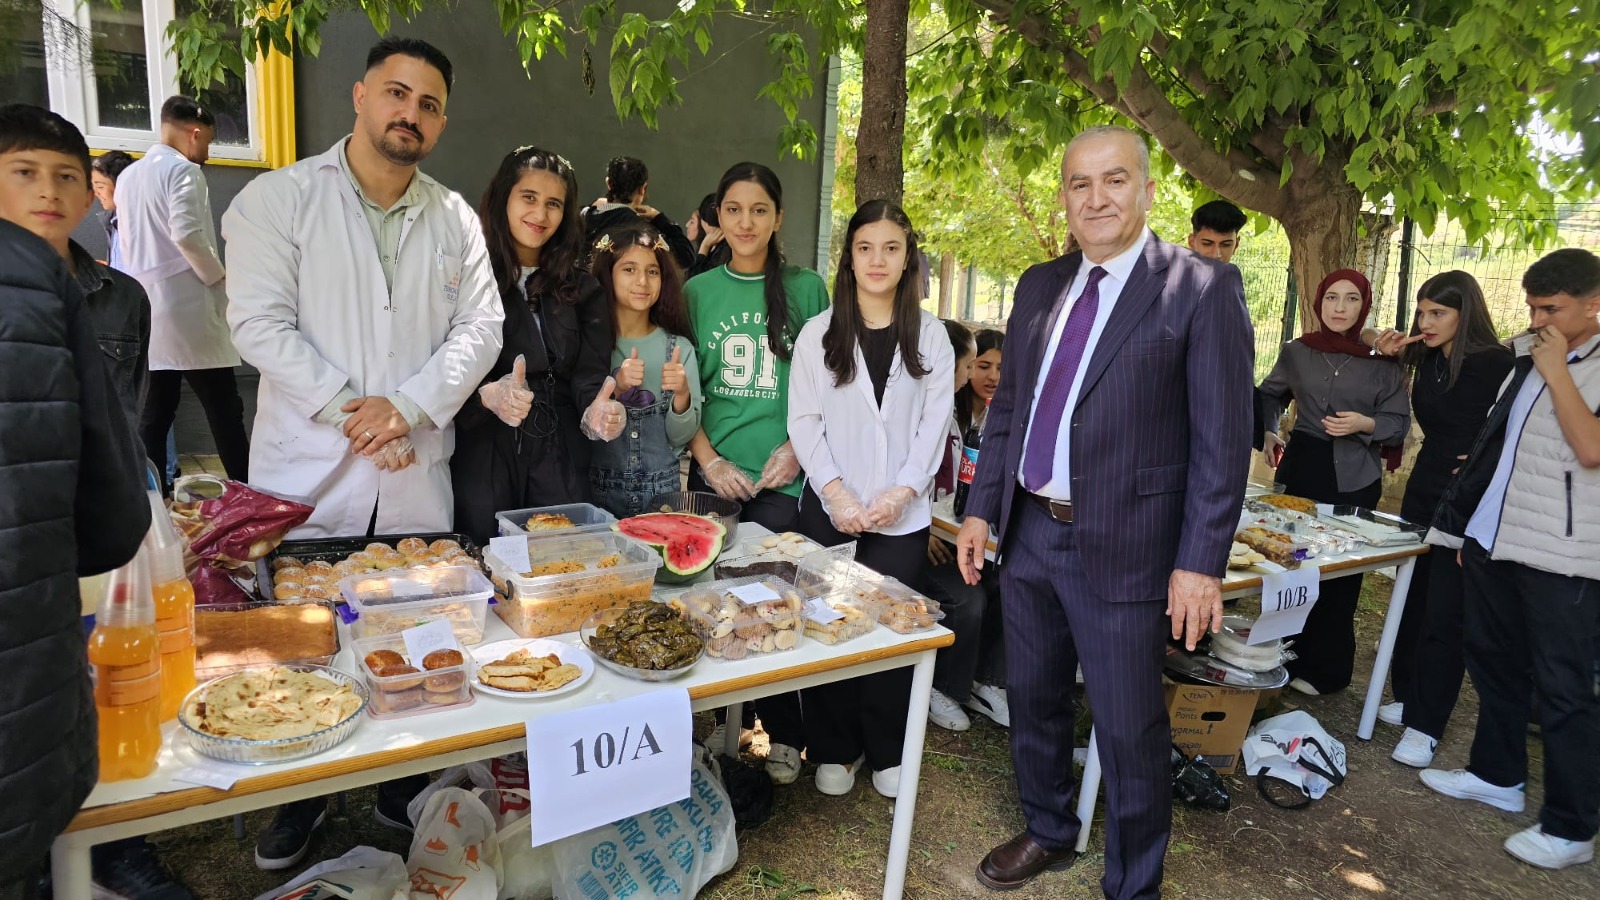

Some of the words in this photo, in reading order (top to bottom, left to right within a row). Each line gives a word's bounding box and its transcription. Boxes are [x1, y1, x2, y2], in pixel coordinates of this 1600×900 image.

[721, 333, 778, 391] 91
[1275, 585, 1308, 612] 10/B
[1171, 727, 1204, 735] NORMAL
[1175, 711, 1198, 720] Pants
[570, 722, 664, 777] 10/A
[690, 768, 723, 816] DAHA
[614, 861, 639, 896] SIFIR
